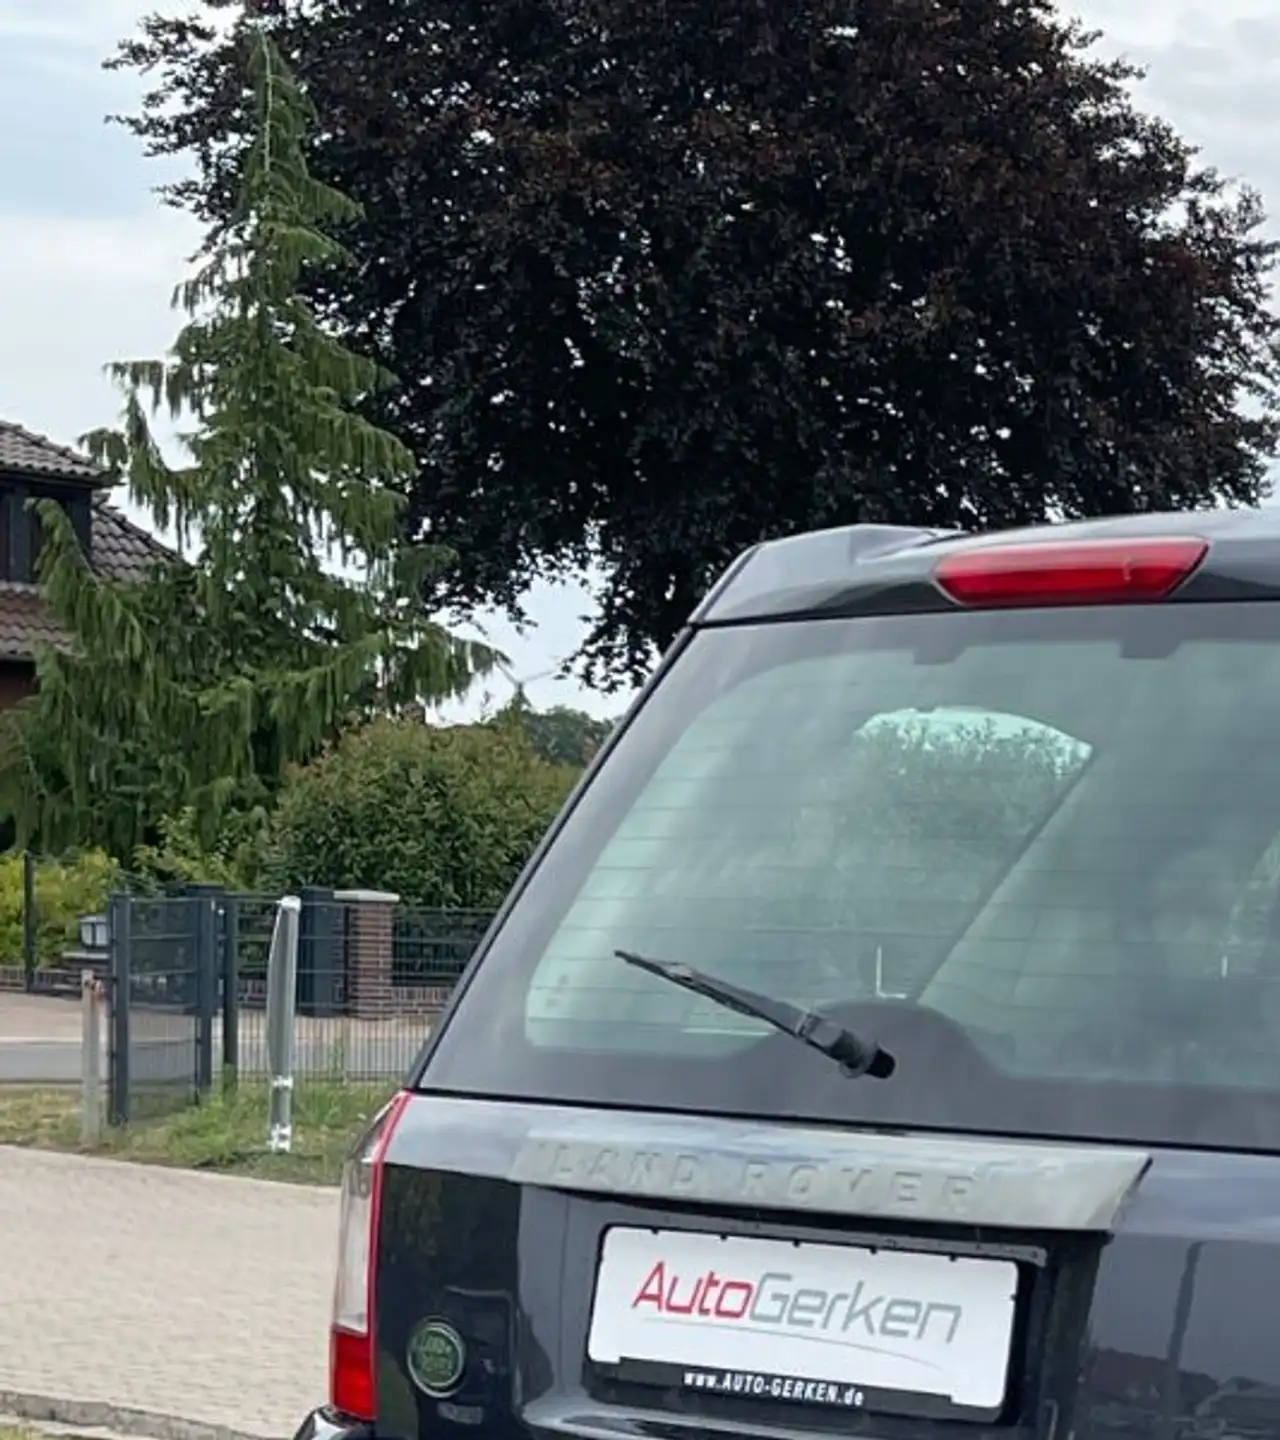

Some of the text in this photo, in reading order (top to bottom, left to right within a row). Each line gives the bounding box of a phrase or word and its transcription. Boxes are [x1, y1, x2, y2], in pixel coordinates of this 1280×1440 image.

[550, 1141, 977, 1215] LAND ROVER
[631, 1260, 963, 1344] AutoGerken
[683, 1370, 864, 1407] www.AUTO-GERKEN.de
